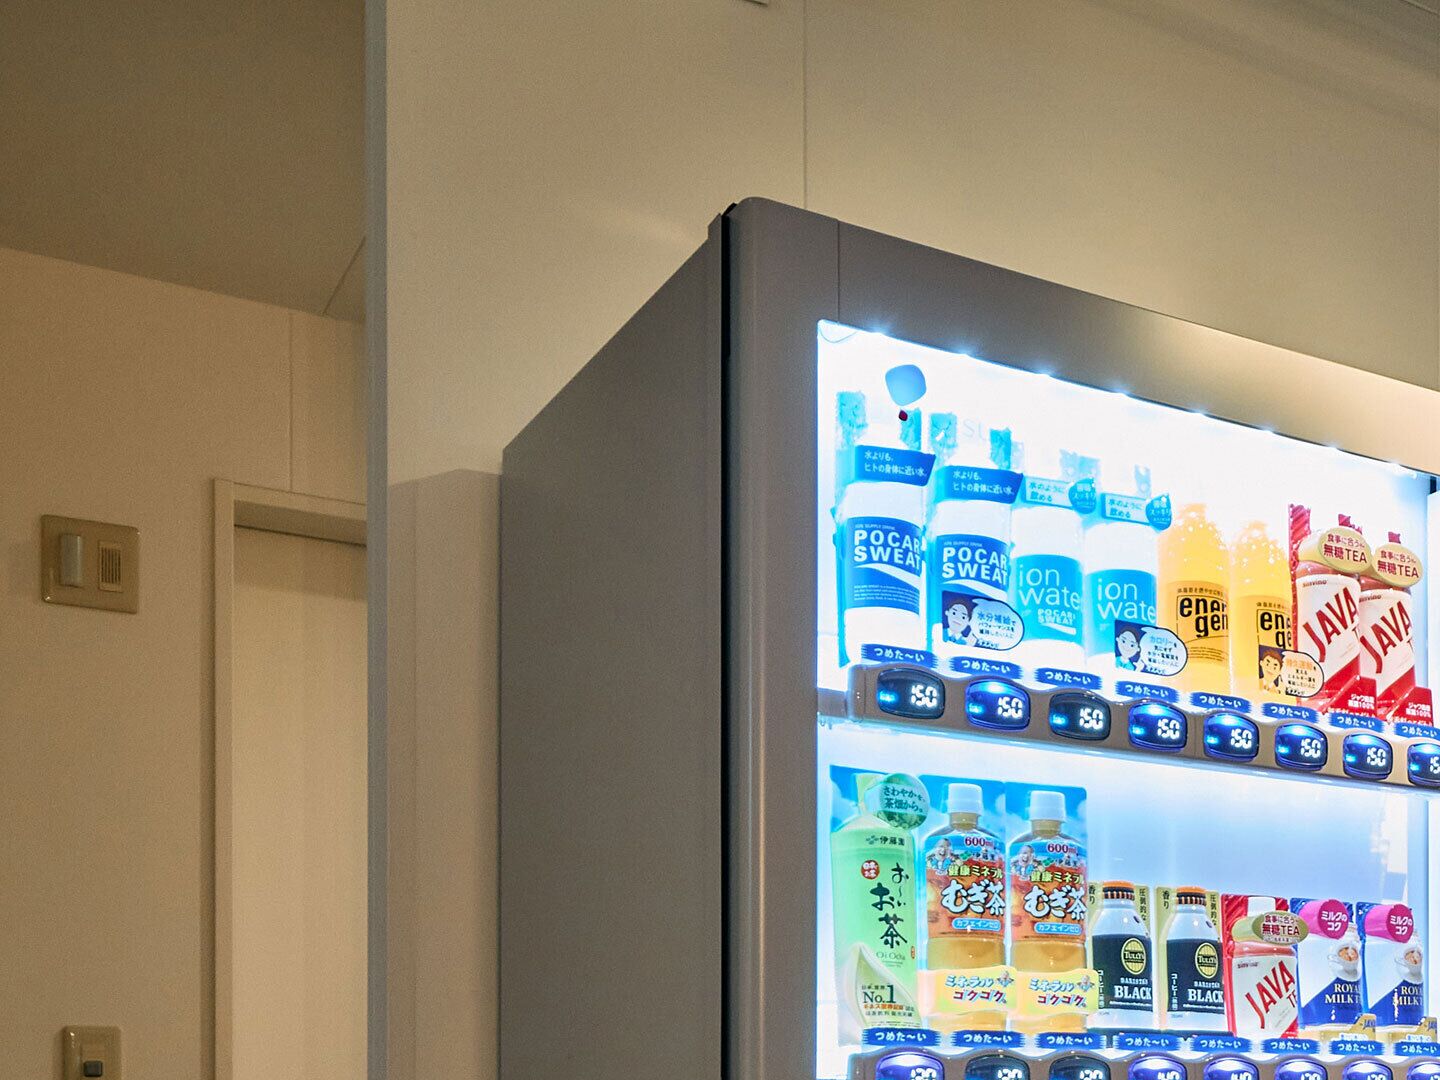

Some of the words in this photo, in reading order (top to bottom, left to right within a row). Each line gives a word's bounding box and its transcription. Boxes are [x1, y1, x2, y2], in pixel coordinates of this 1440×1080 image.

[853, 546, 920, 571] SWEAT
[1324, 544, 1367, 563] 無糖TEA
[941, 563, 1008, 586] SWEAT
[1019, 565, 1060, 587] ion
[1378, 560, 1419, 578] 無糖TEA
[1097, 578, 1138, 600] ion
[1303, 587, 1358, 662] JAVA
[1361, 600, 1412, 673] JAVA
[911, 684, 938, 708] 150
[997, 696, 1023, 719] 150
[1079, 707, 1104, 730] 150
[1157, 718, 1180, 740] 150
[1230, 728, 1253, 749] 150
[1300, 738, 1321, 758] 150
[1366, 747, 1387, 767] 150
[941, 879, 1005, 917] むぎ茶
[1024, 885, 1087, 920] むぎ茶
[1321, 910, 1348, 922] ミルクの
[1262, 923, 1300, 936] 無糖TEA
[1327, 922, 1342, 932] コク
[1395, 925, 1408, 935] コク
[945, 975, 993, 989] ミネラル
[1028, 978, 1074, 992] ミネラル
[1114, 985, 1151, 1000] BLACK
[1188, 989, 1223, 1003] BLACK
[1245, 960, 1295, 1029] JAVA
